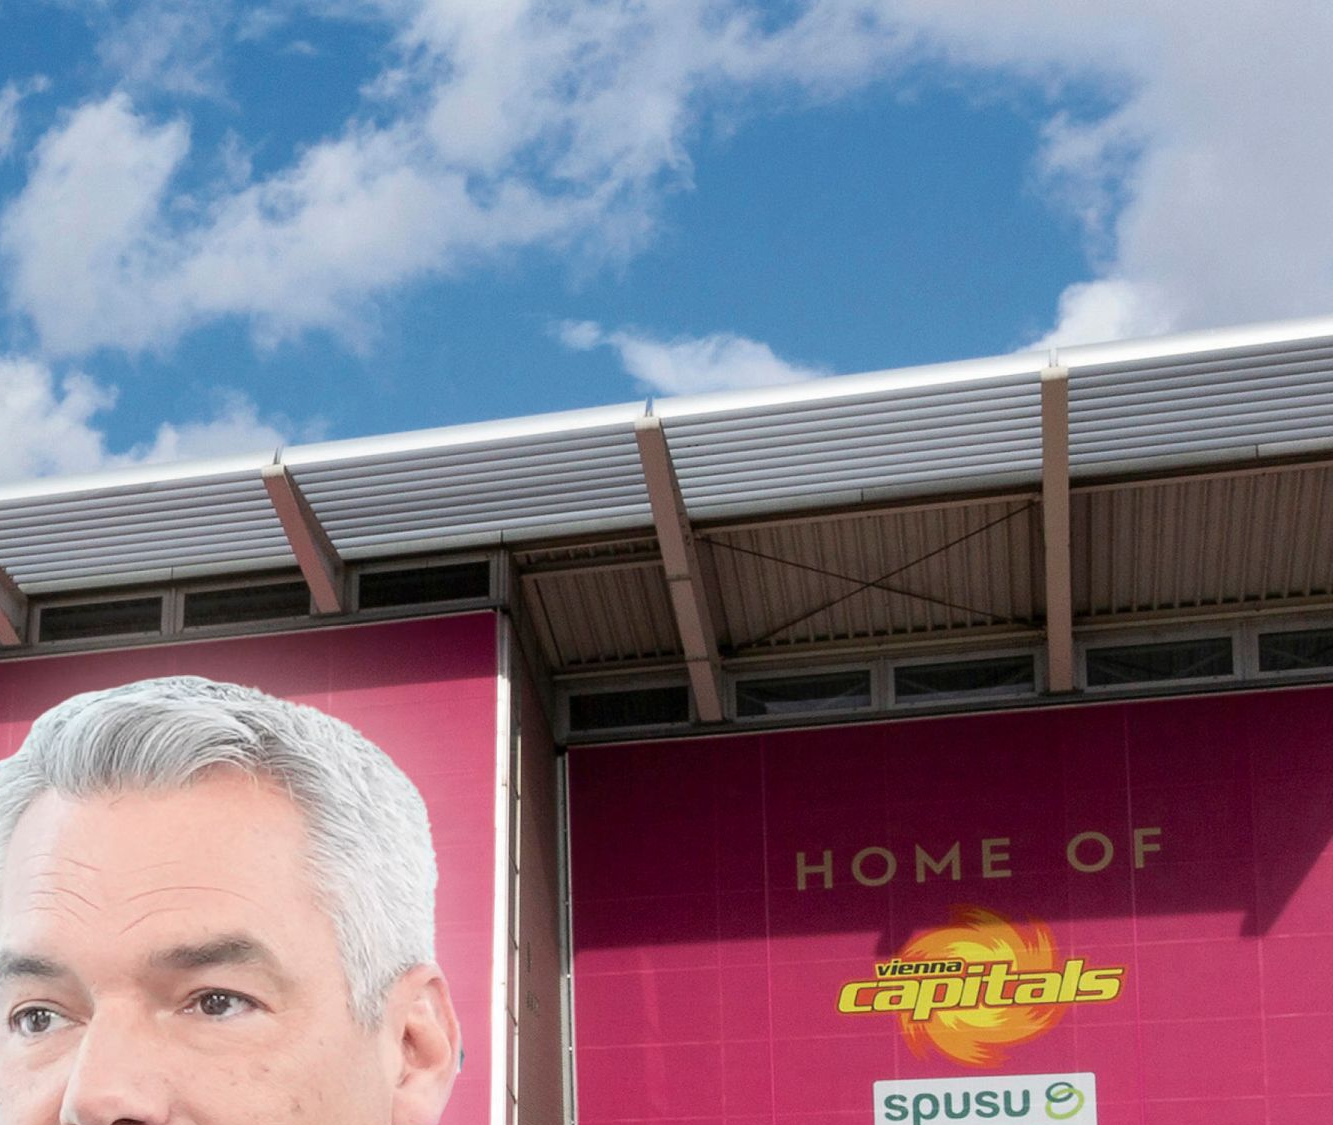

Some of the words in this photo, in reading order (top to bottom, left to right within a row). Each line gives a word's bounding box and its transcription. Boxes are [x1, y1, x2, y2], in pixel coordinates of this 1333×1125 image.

[796, 840, 1012, 890] HOME
[1067, 827, 1162, 873] OF
[838, 960, 1124, 1020] capitals
[877, 960, 962, 976] vienna
